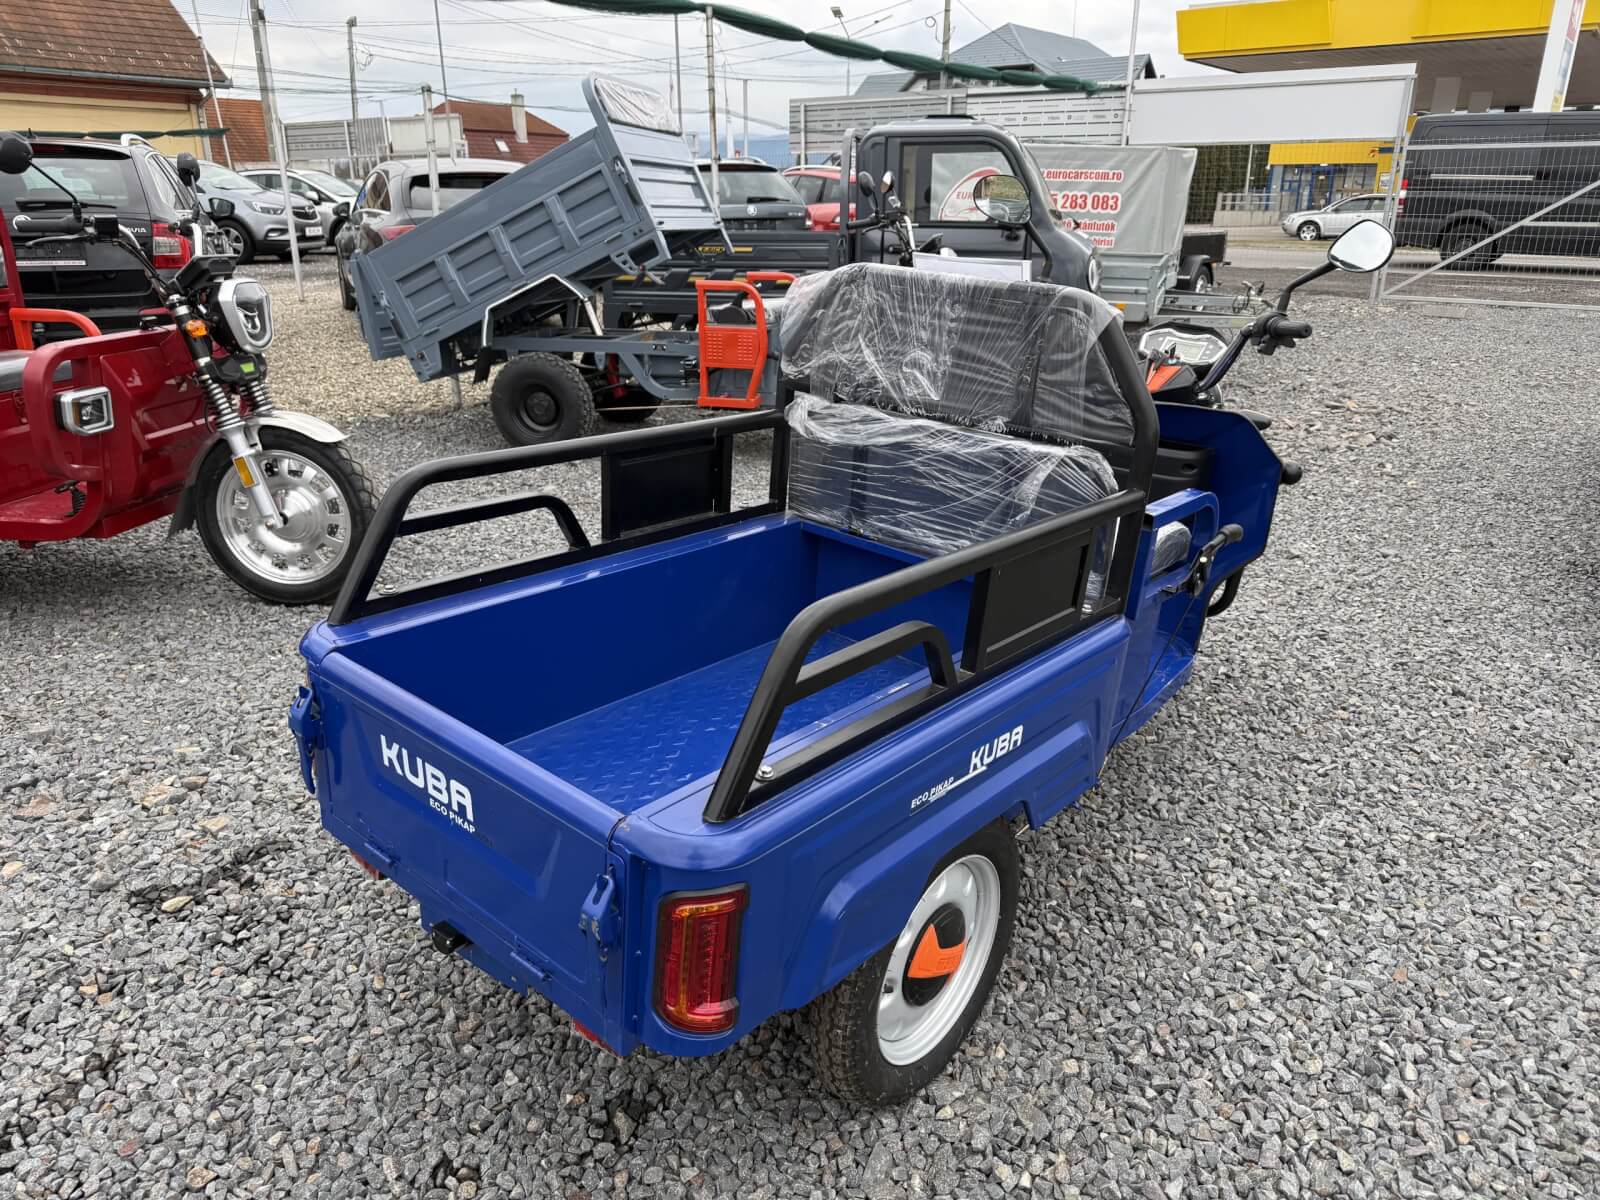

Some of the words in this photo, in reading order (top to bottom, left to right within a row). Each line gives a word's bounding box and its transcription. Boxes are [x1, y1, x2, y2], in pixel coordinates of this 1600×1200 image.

[1060, 192, 1088, 211] 283
[1091, 193, 1120, 212] 083
[969, 725, 1023, 773] KUBA
[380, 734, 474, 822] KUBA
[911, 792, 929, 808] ECO
[930, 777, 954, 798] PIKAP
[429, 798, 447, 815] ECO
[449, 811, 475, 833] PIKAP
